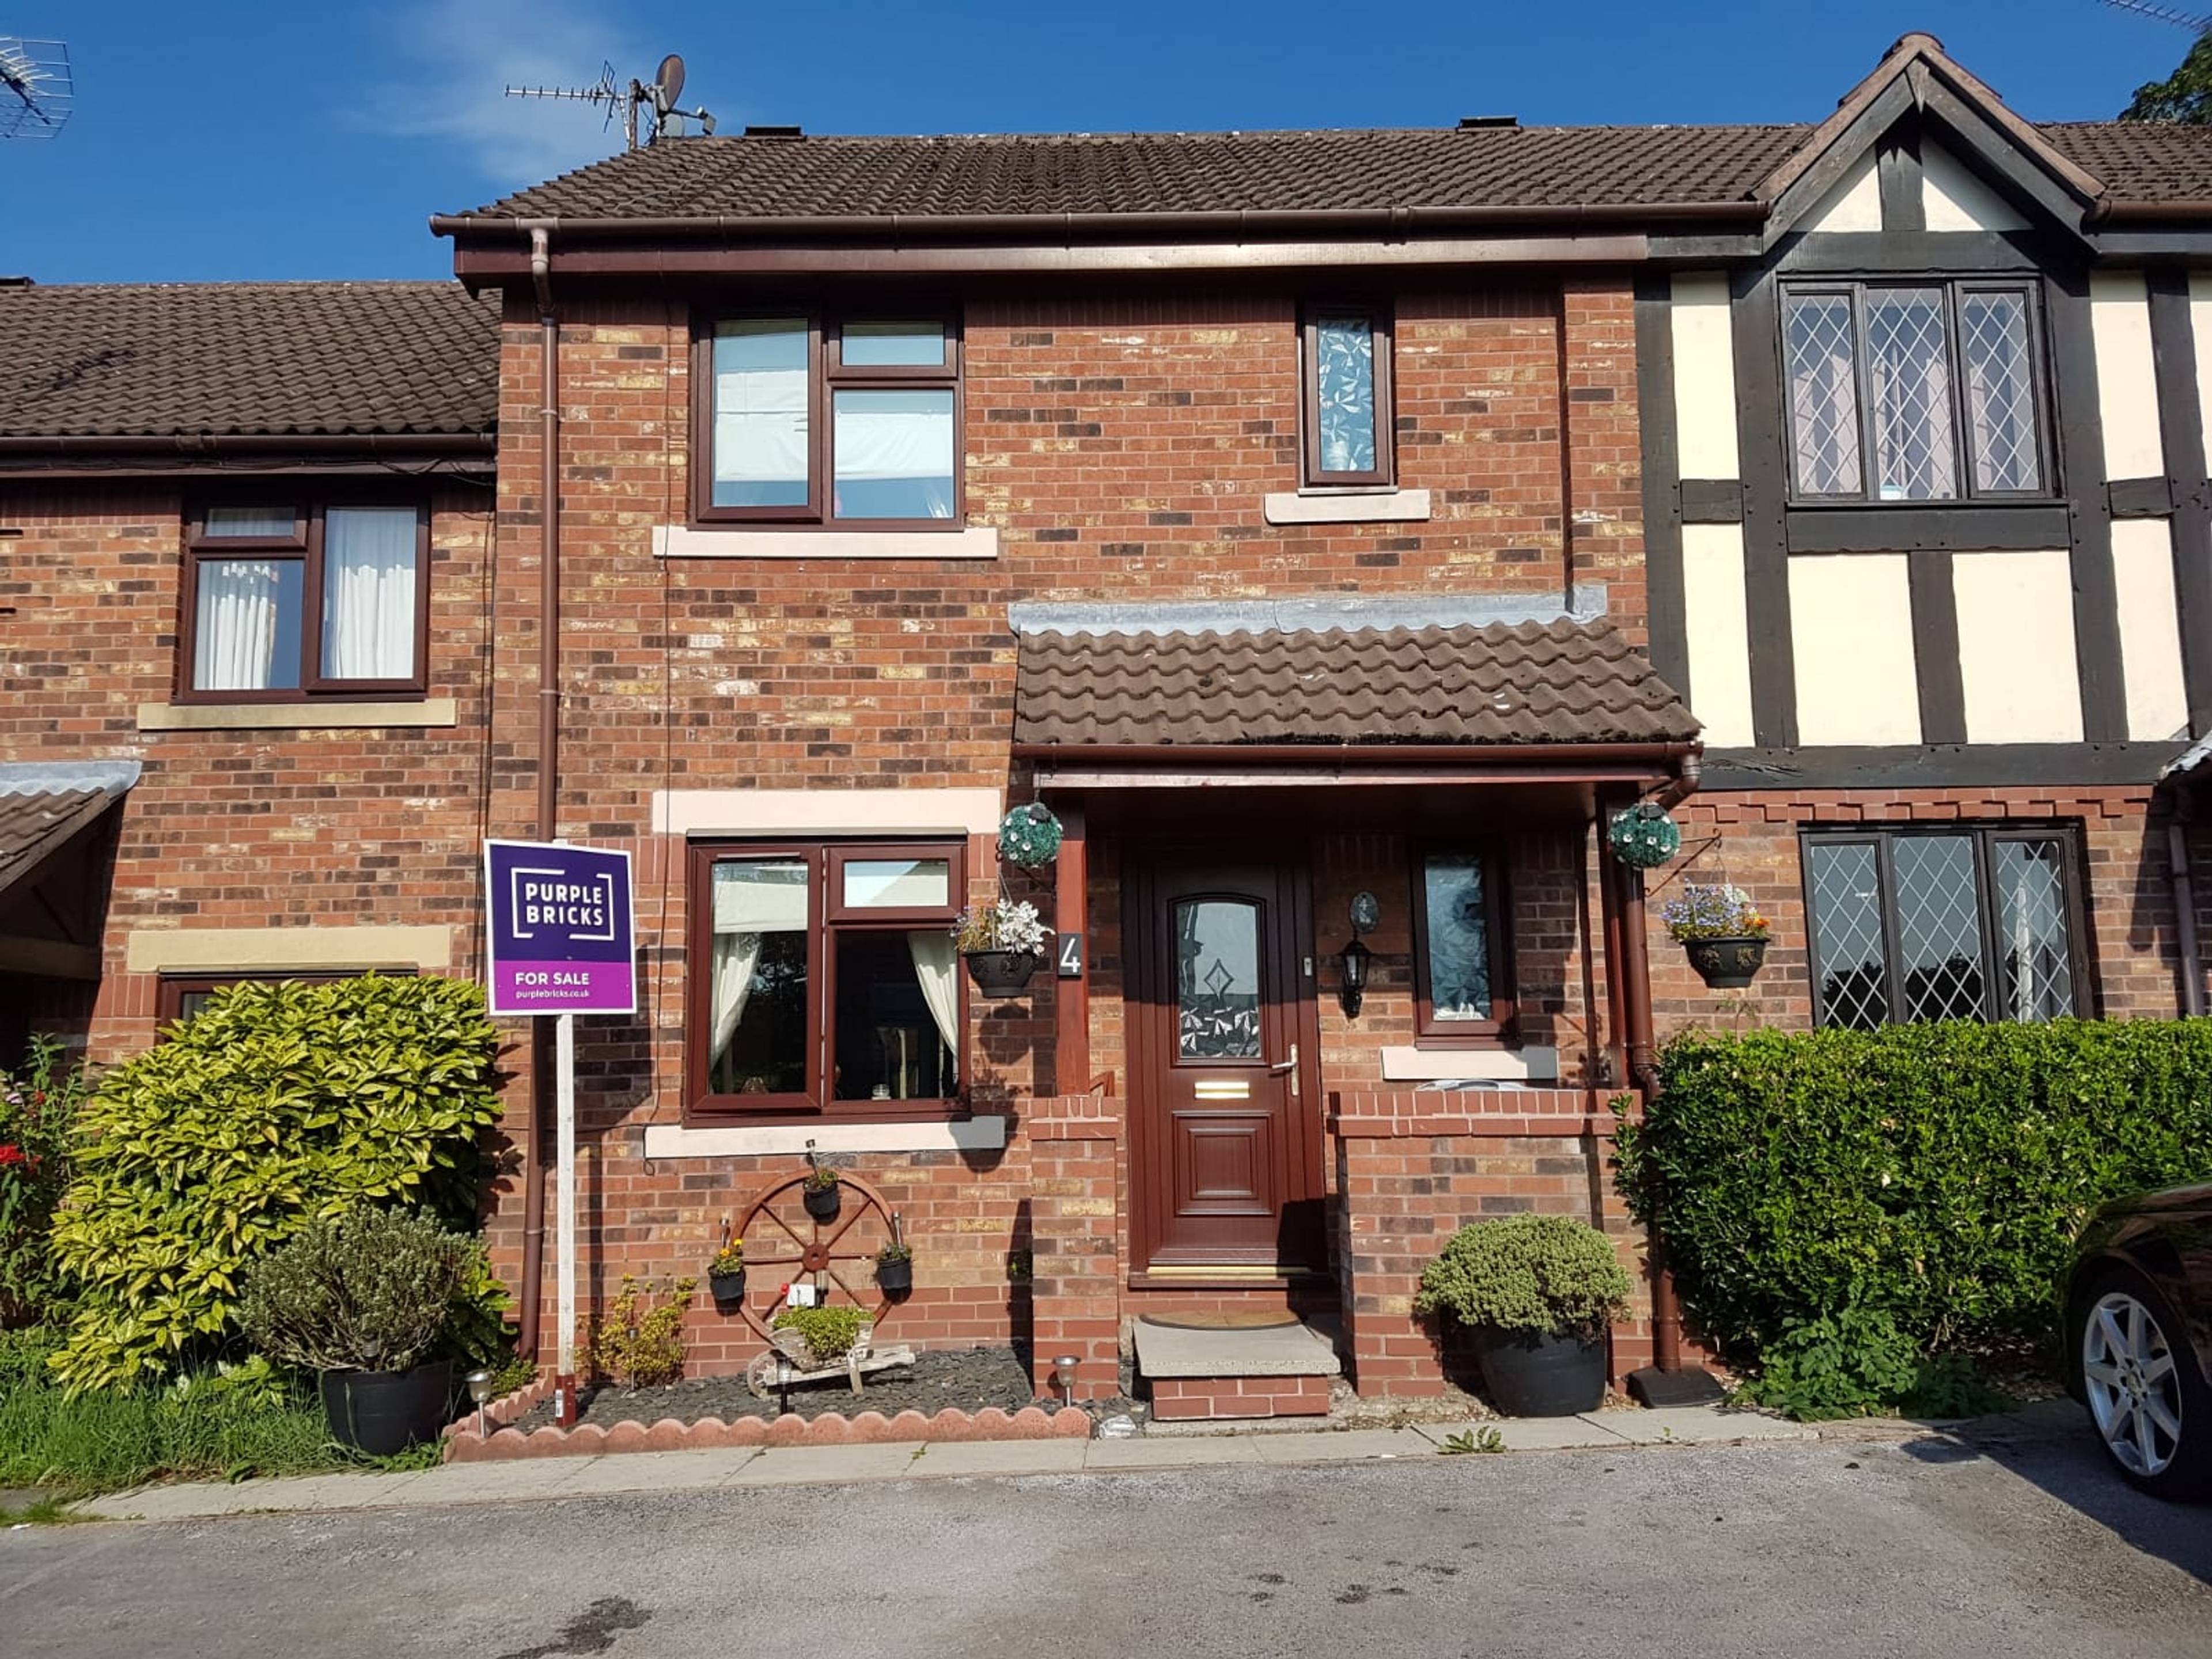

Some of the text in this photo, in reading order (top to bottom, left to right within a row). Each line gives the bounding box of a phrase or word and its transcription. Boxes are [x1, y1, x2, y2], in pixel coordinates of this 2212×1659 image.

[525, 882, 603, 904] PURPLE
[526, 905, 603, 926] BRICKS
[1060, 938, 1081, 973] 4
[515, 972, 590, 985] FOR SALE
[516, 989, 589, 999] purplebricks.co.uk
